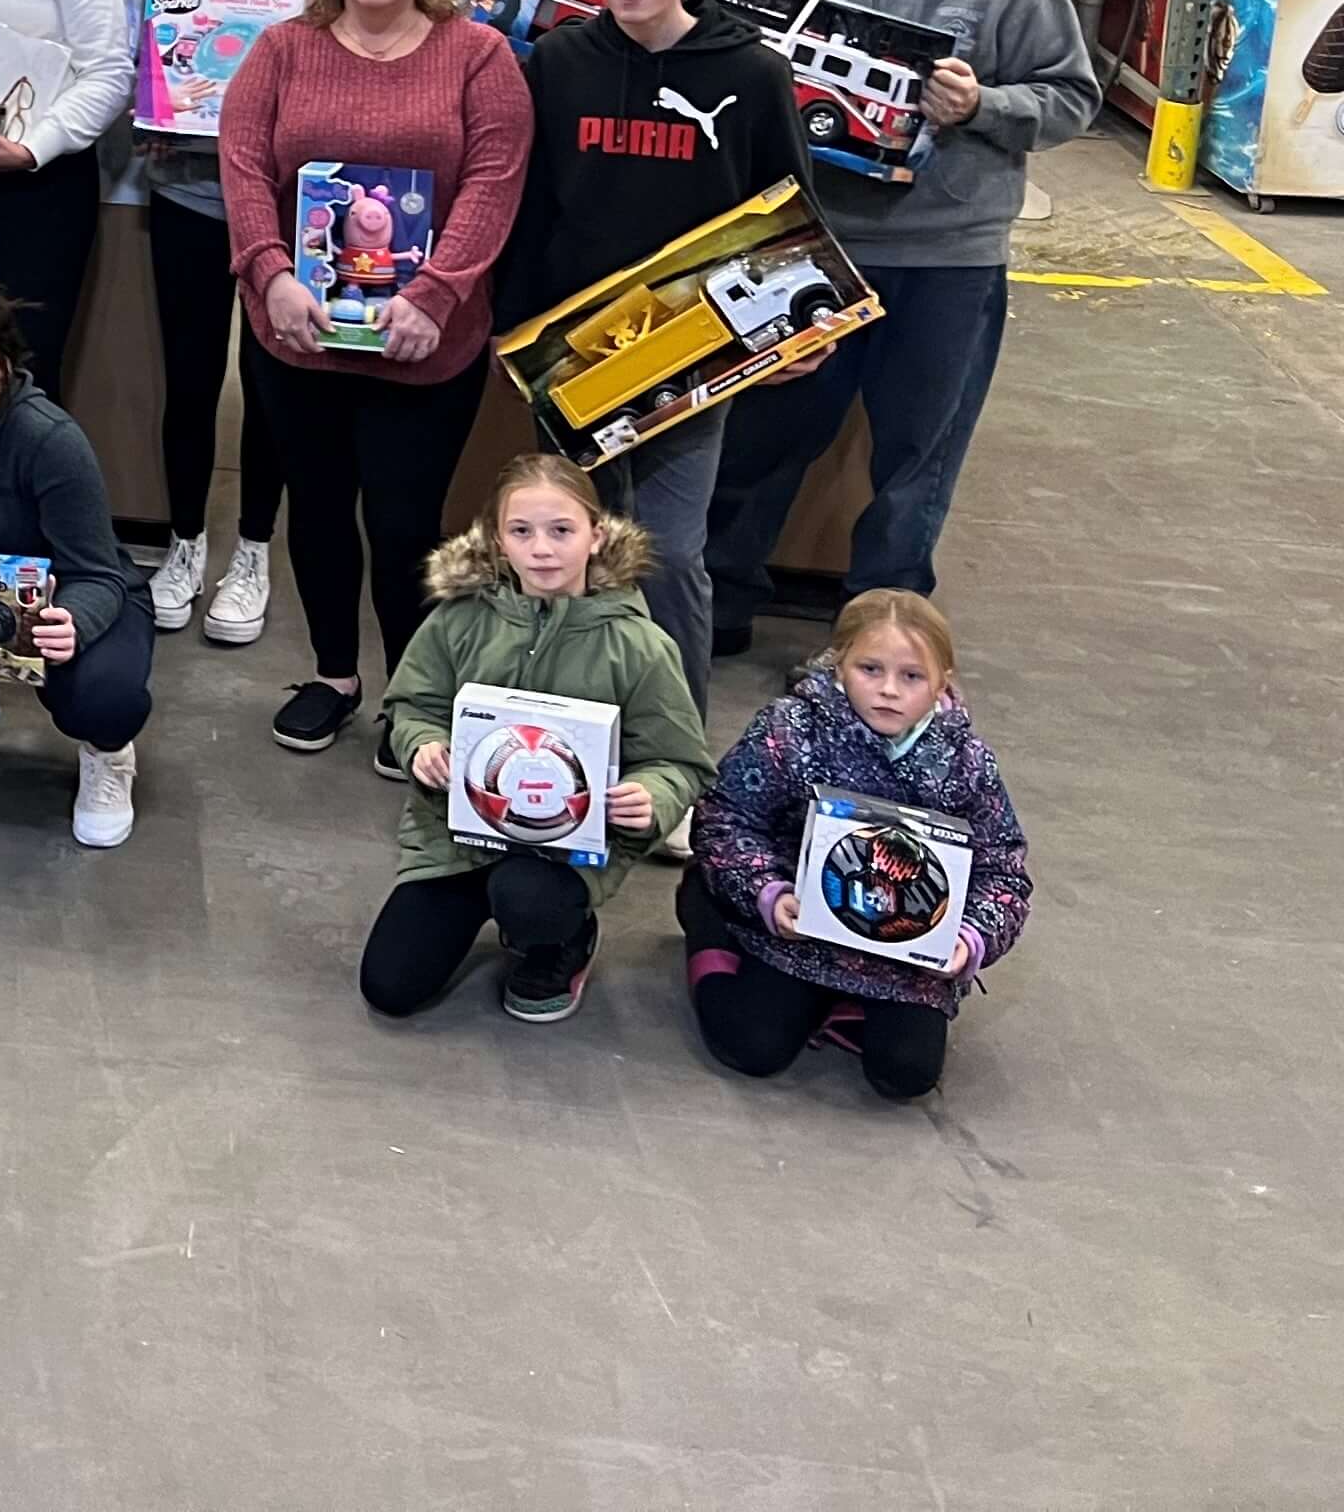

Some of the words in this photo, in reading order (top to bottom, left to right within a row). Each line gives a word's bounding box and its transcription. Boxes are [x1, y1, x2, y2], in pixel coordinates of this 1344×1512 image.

[863, 101, 886, 123] 01
[578, 115, 696, 161] PUMA
[460, 707, 496, 721] Franklin
[486, 840, 508, 852] BALL
